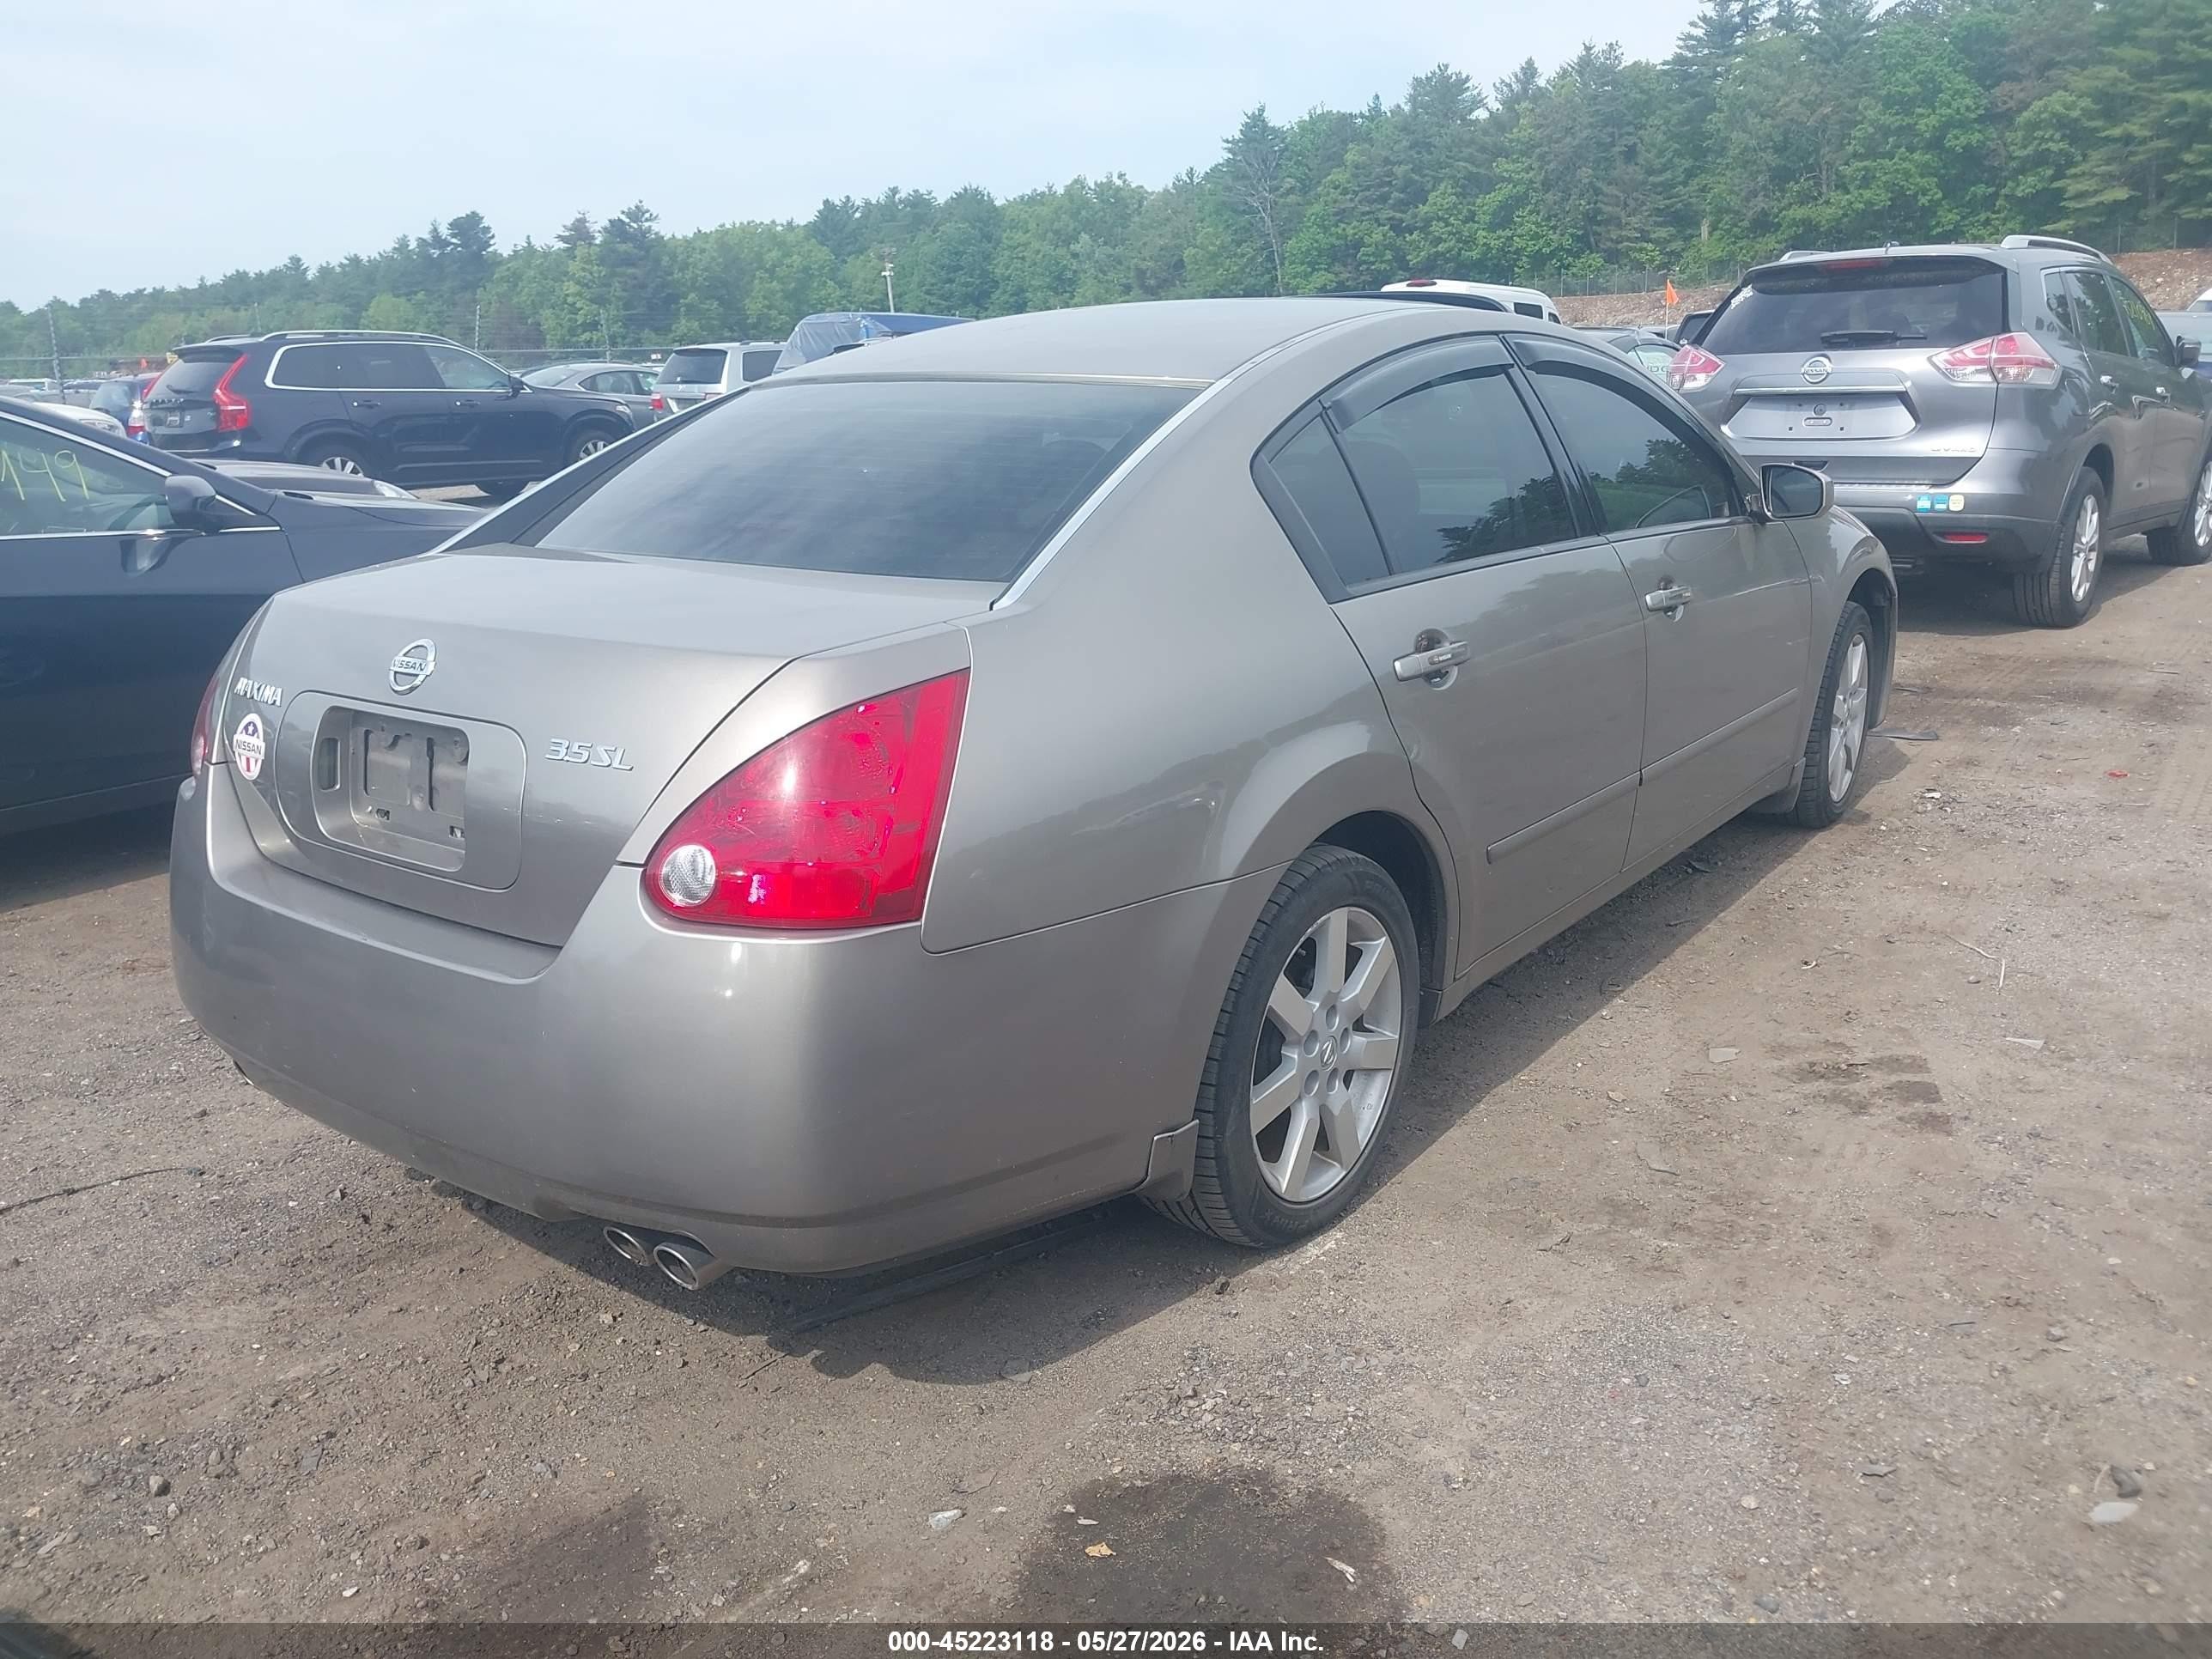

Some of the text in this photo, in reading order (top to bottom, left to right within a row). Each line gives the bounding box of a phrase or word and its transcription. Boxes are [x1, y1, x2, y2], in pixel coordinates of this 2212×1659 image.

[392, 659, 428, 672] NISSAN
[234, 677, 283, 708] MAXIMA
[235, 739, 263, 756] NISSAN
